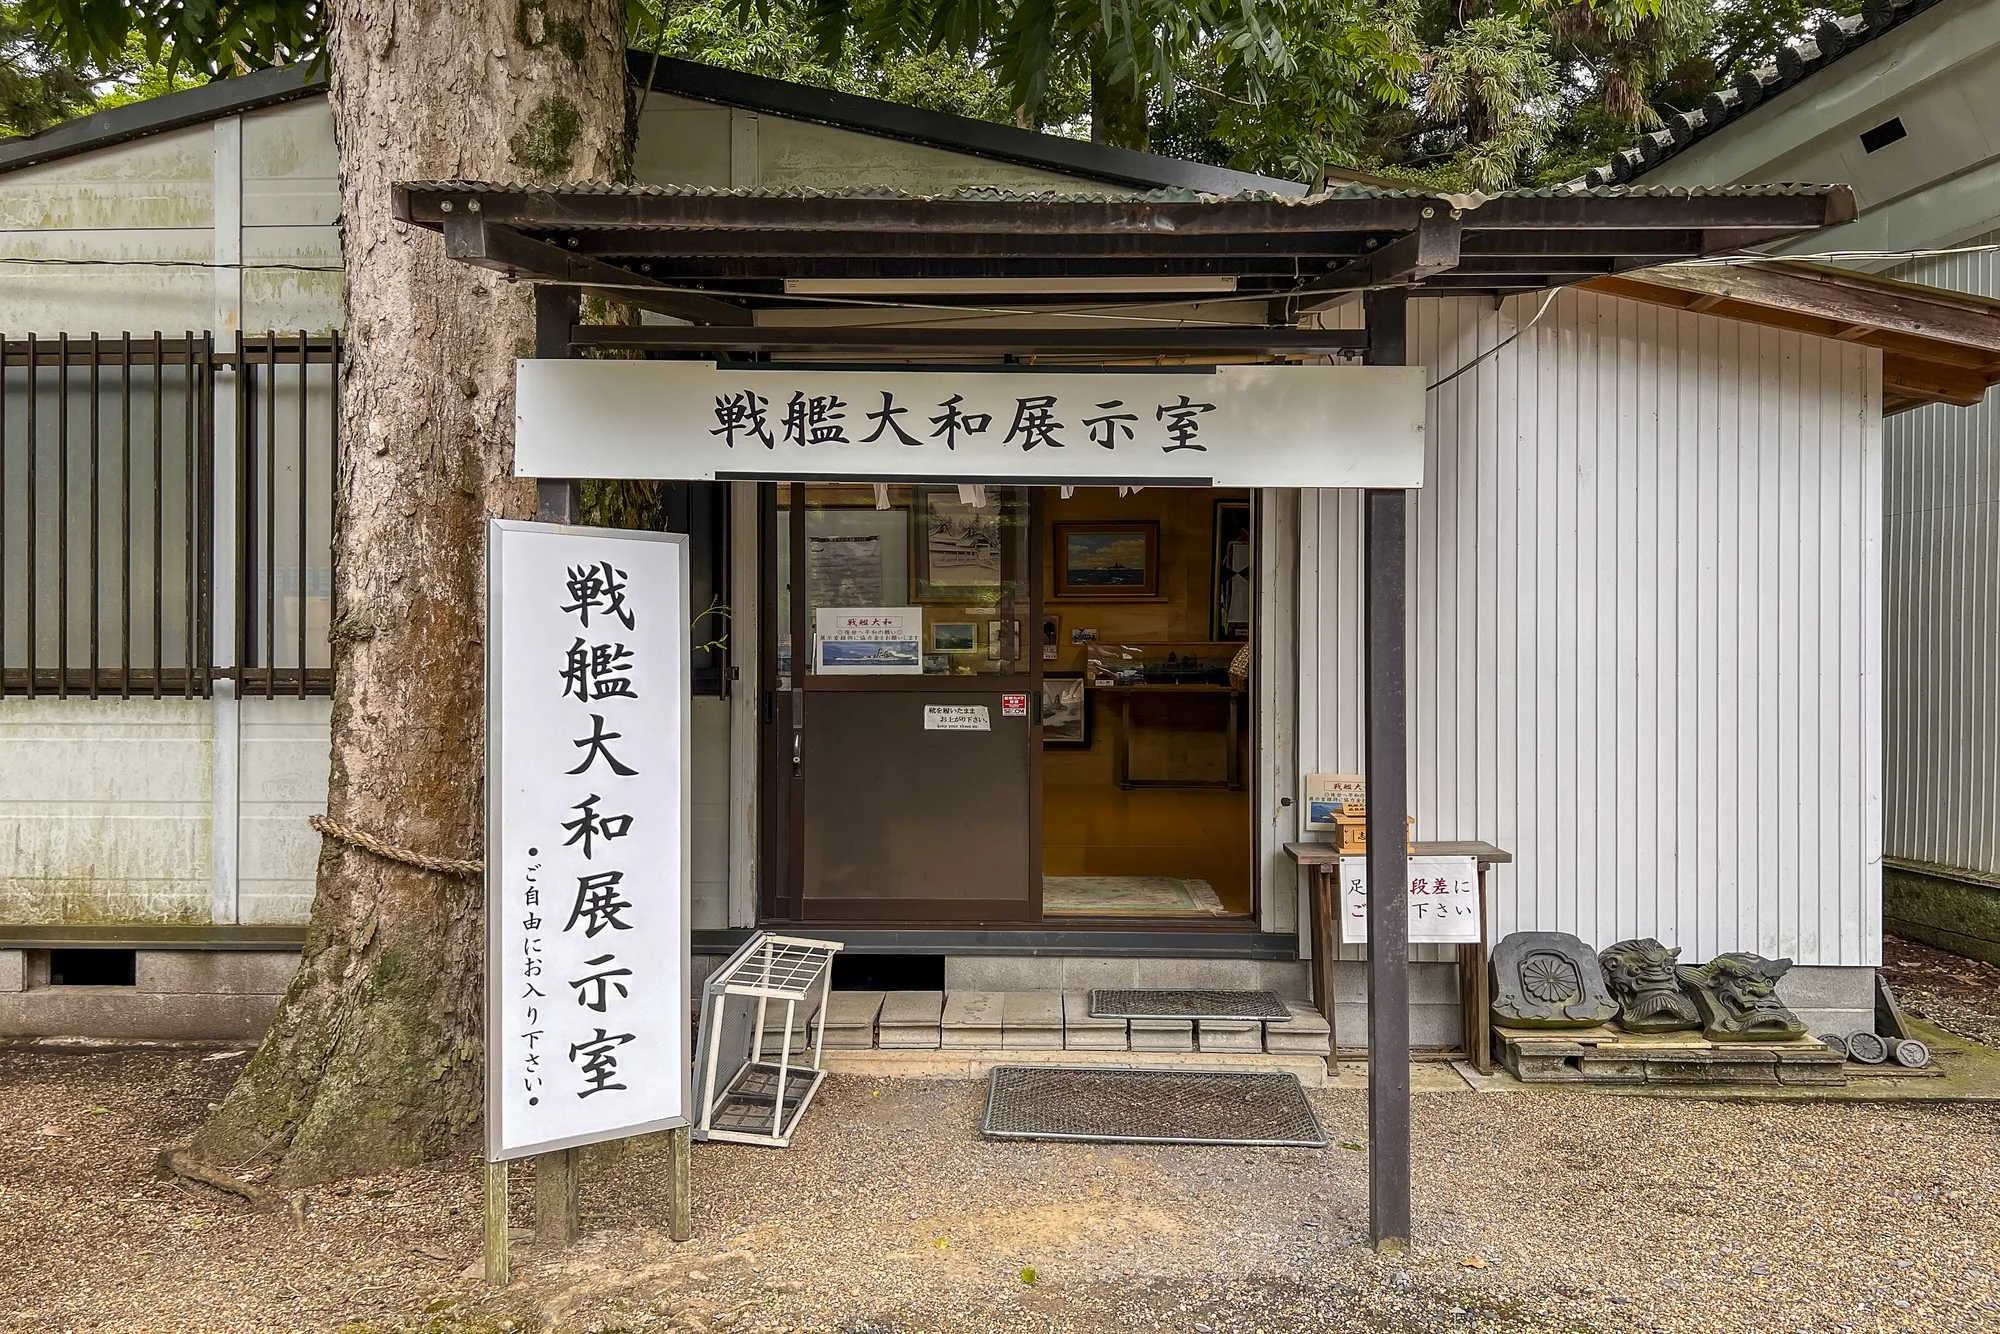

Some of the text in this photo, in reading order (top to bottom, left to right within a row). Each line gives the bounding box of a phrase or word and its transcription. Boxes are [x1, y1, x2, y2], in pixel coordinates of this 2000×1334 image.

[709, 390, 1217, 453] 戦艦大和展示室
[847, 618, 893, 627] 戦艦大和
[559, 561, 640, 1099] 戦艦大和展示室
[1348, 878, 1470, 895] 足段差に
[1352, 903, 1472, 919] ご下さい
[521, 863, 546, 1092] ご自由にお入り下さい
